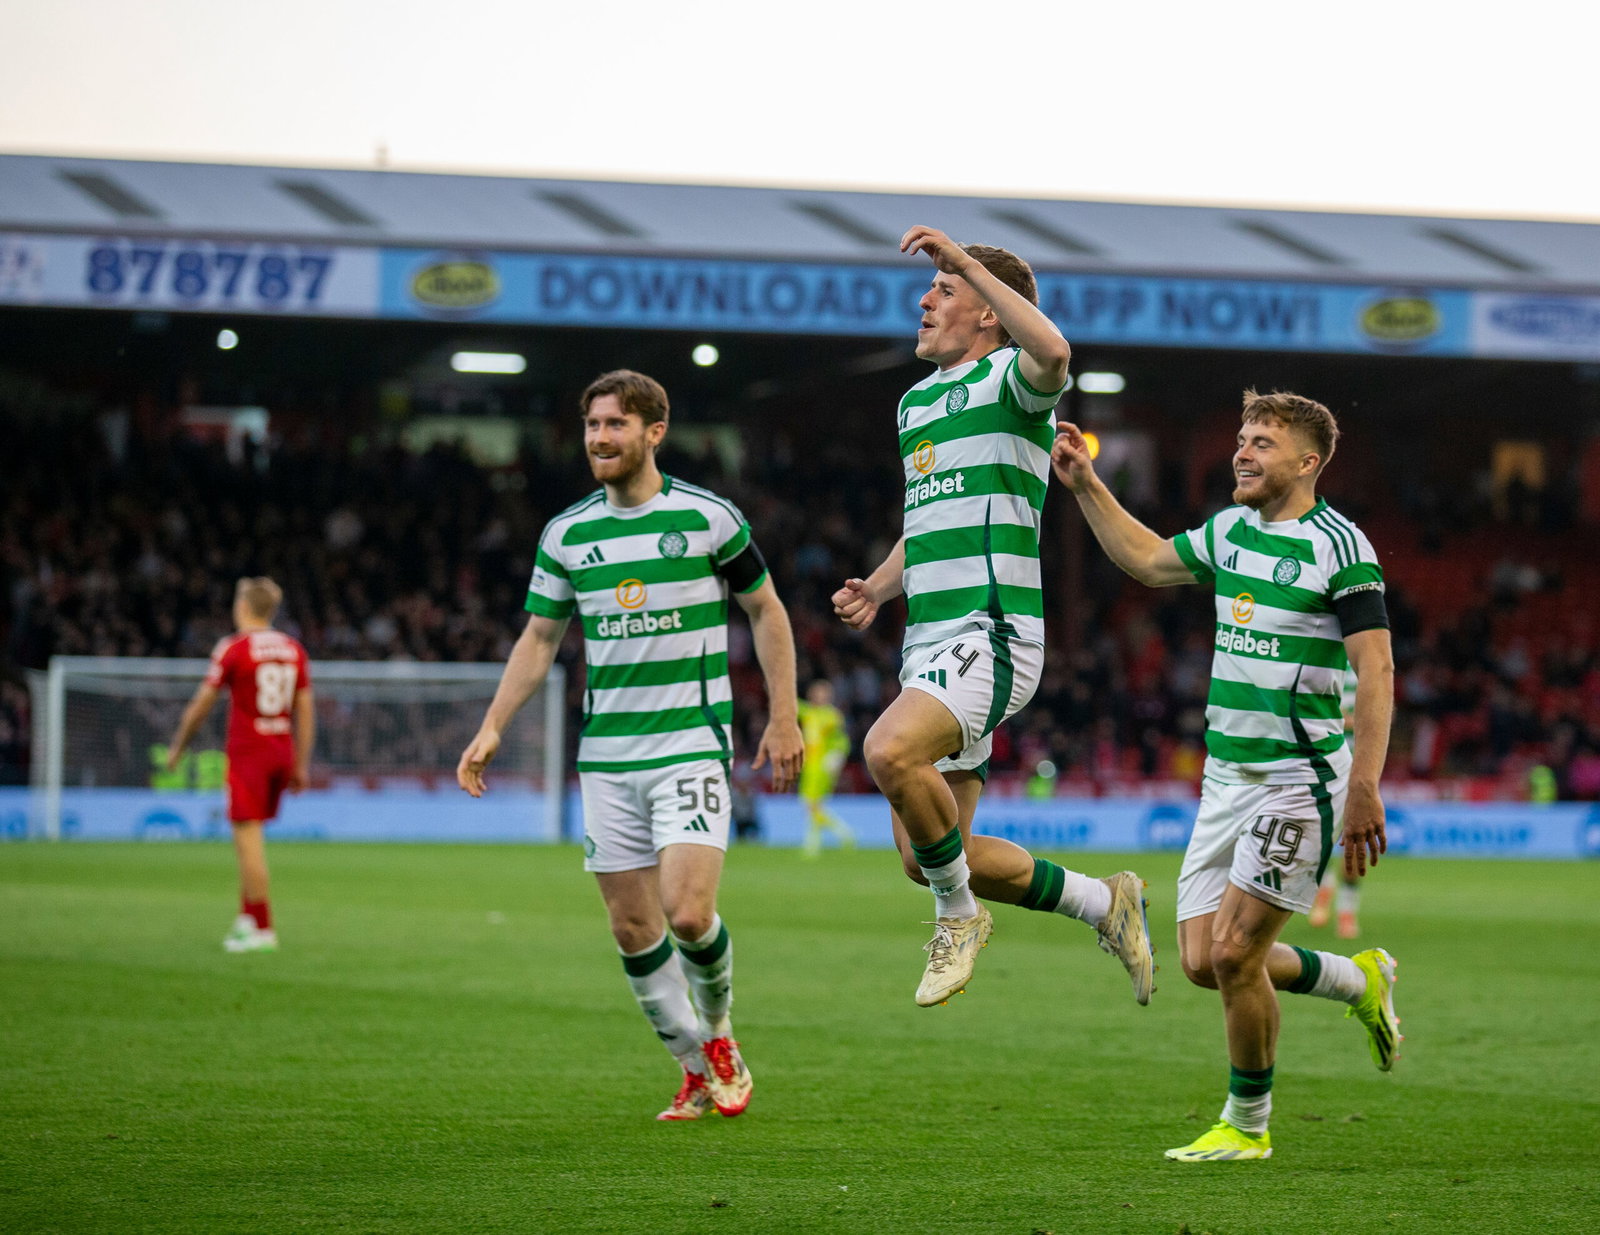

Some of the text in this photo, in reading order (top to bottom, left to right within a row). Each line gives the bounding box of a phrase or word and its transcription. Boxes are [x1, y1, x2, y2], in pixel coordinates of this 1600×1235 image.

[87, 245, 335, 301] 878787
[537, 264, 885, 317] DOWNLOAD
[1046, 284, 1146, 329] APP
[1159, 289, 1322, 337] NOW!
[597, 610, 682, 638] dafabet
[1216, 624, 1280, 658] dafabet
[255, 663, 298, 717] 81
[677, 777, 720, 814] 56
[1252, 815, 1303, 866] 49
